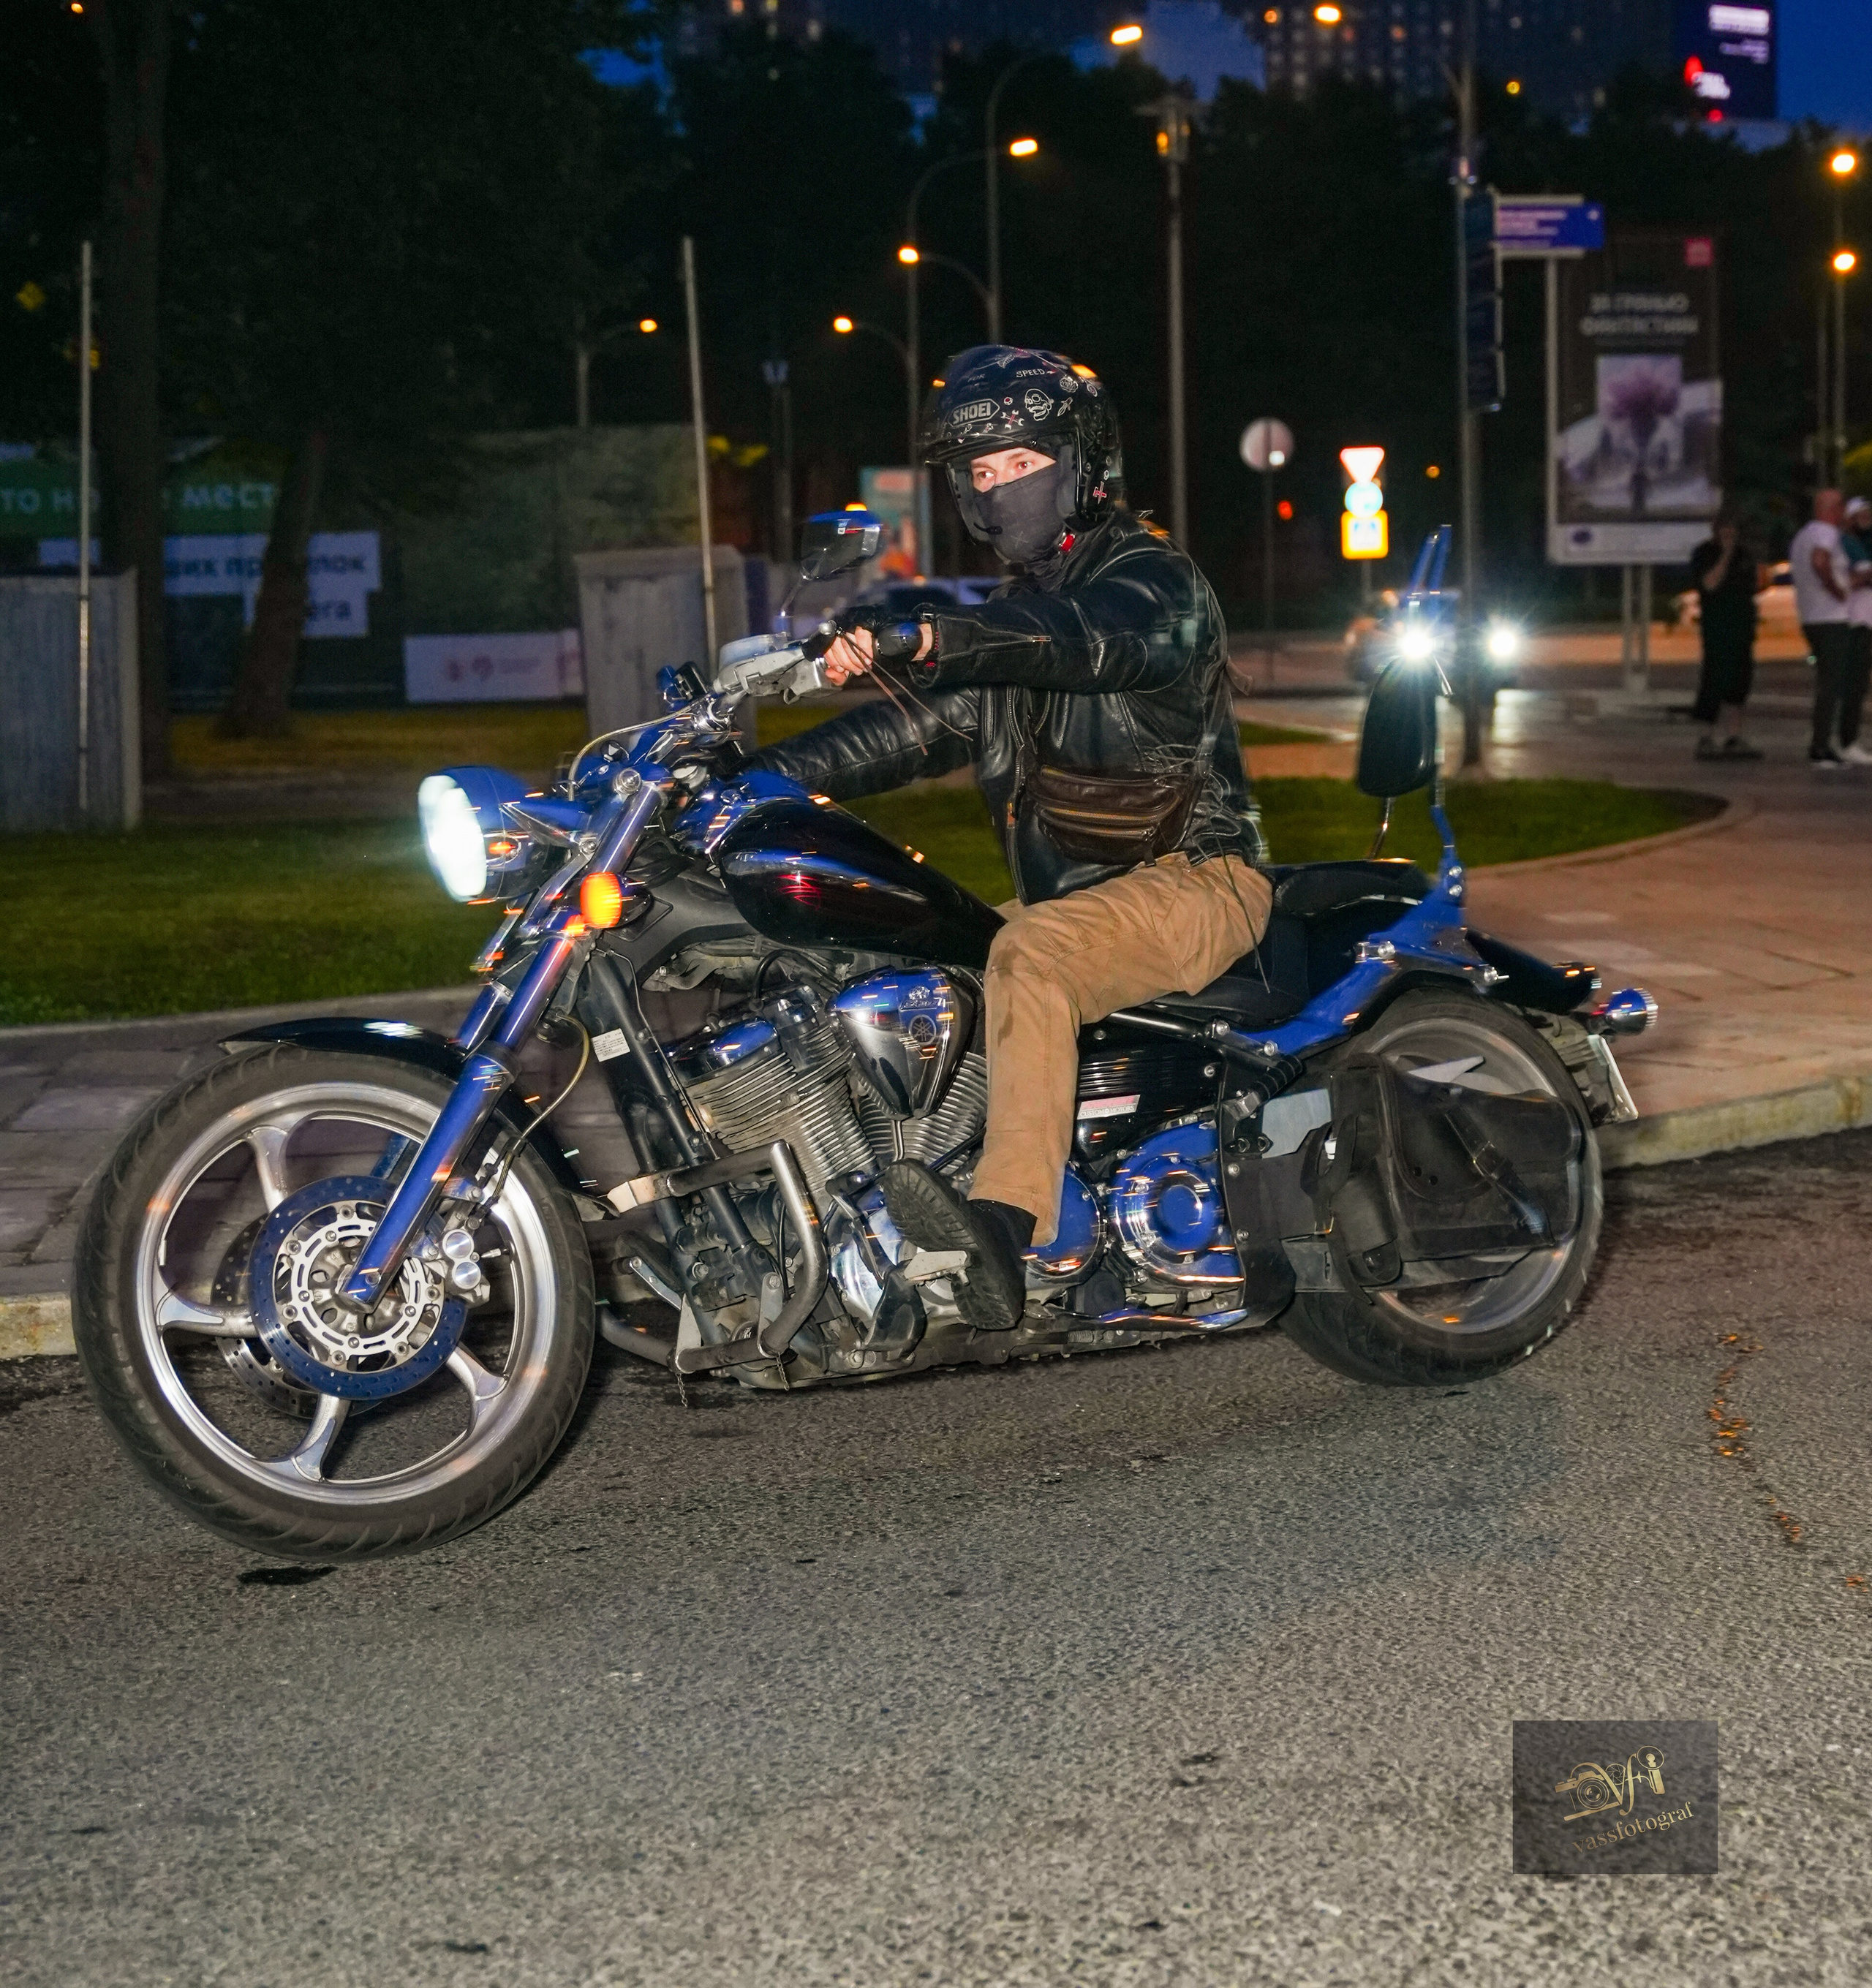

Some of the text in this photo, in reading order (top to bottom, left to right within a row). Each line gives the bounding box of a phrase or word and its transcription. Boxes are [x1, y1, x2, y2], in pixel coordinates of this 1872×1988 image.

[1016, 369, 1046, 378] SPEED
[953, 401, 992, 425] SHOEI
[1080, 1105, 1135, 1117] CUSTOM MOTORS
